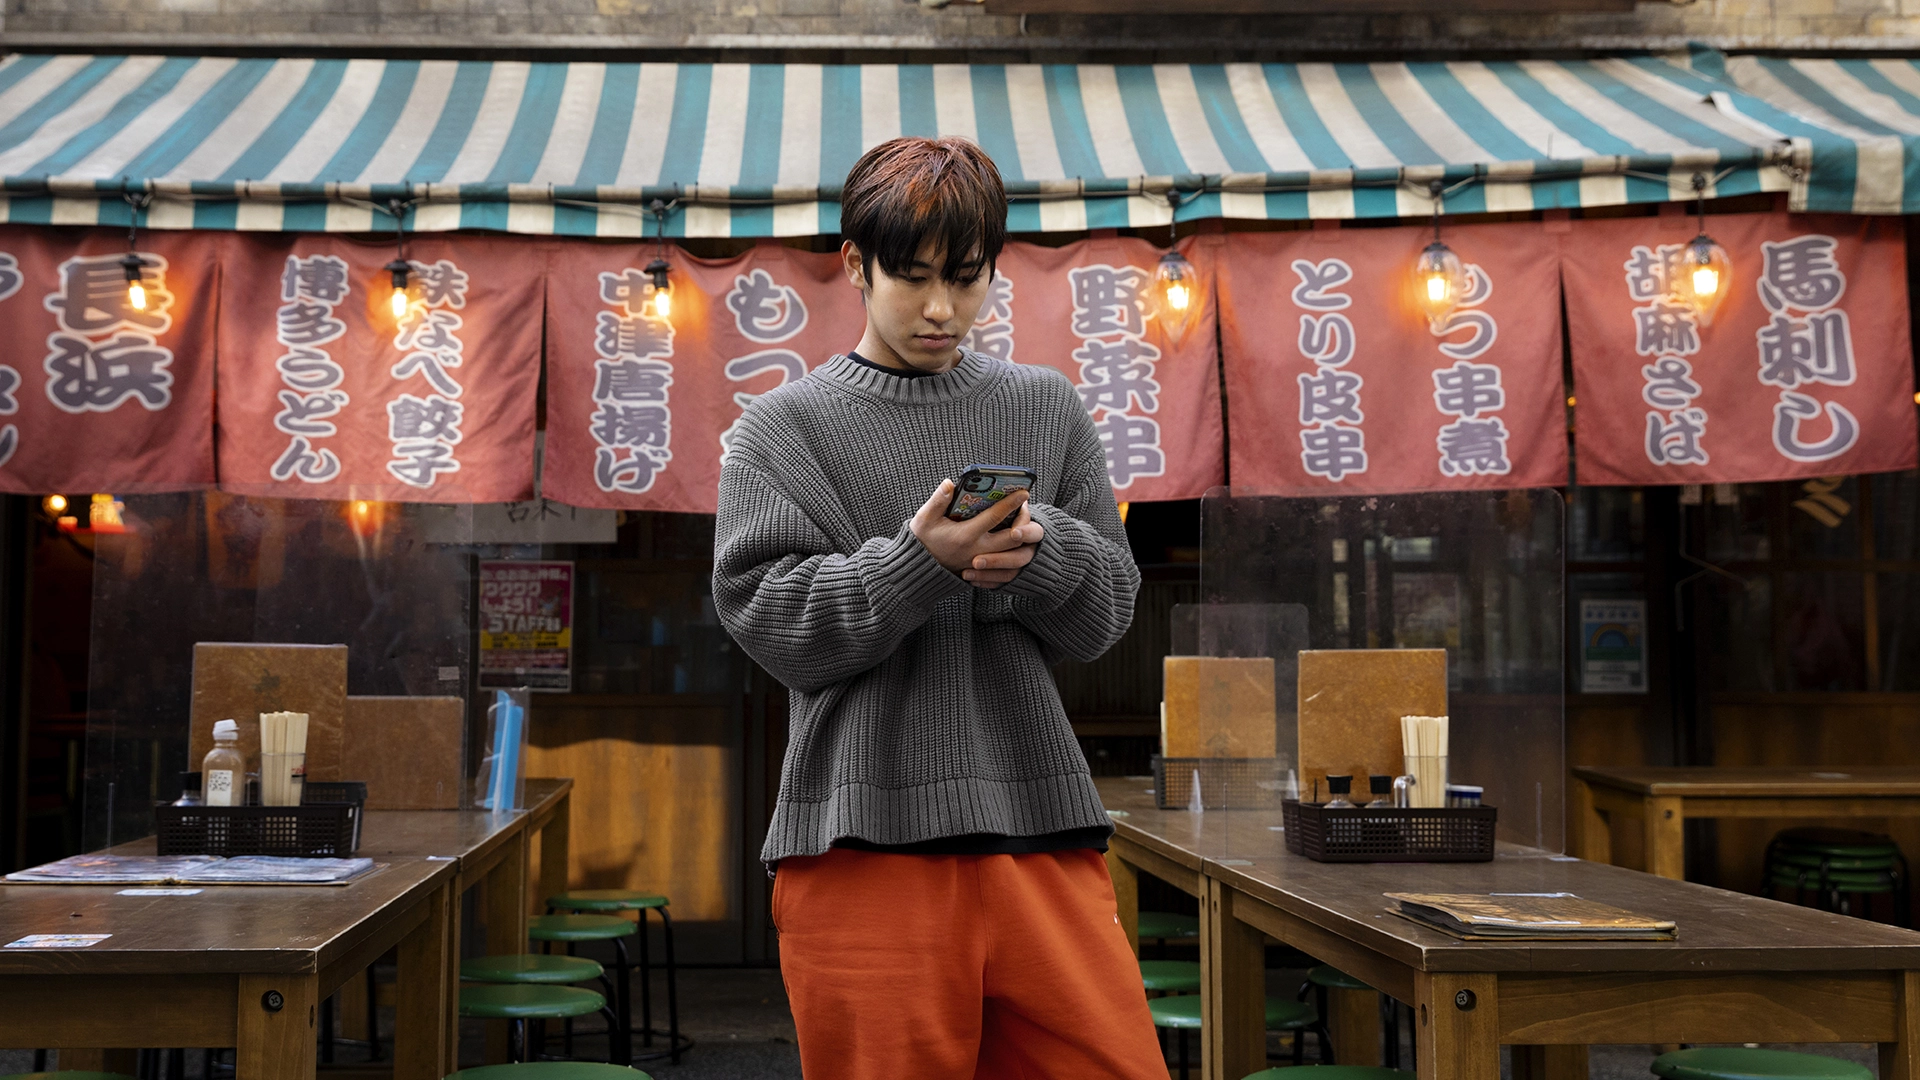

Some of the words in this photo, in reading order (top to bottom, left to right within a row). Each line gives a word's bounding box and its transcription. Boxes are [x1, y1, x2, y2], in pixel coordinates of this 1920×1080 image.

[43, 252, 175, 413] 長浜
[271, 254, 350, 482] 博多うどん
[386, 259, 469, 489] 鉄なべ餃子
[589, 268, 676, 494] 中津唐揚げ
[1068, 264, 1165, 490] 野菜串
[1291, 258, 1368, 482] とり皮串
[1624, 243, 1709, 466] 胡麻さば
[1757, 234, 1860, 463] 馬刺し
